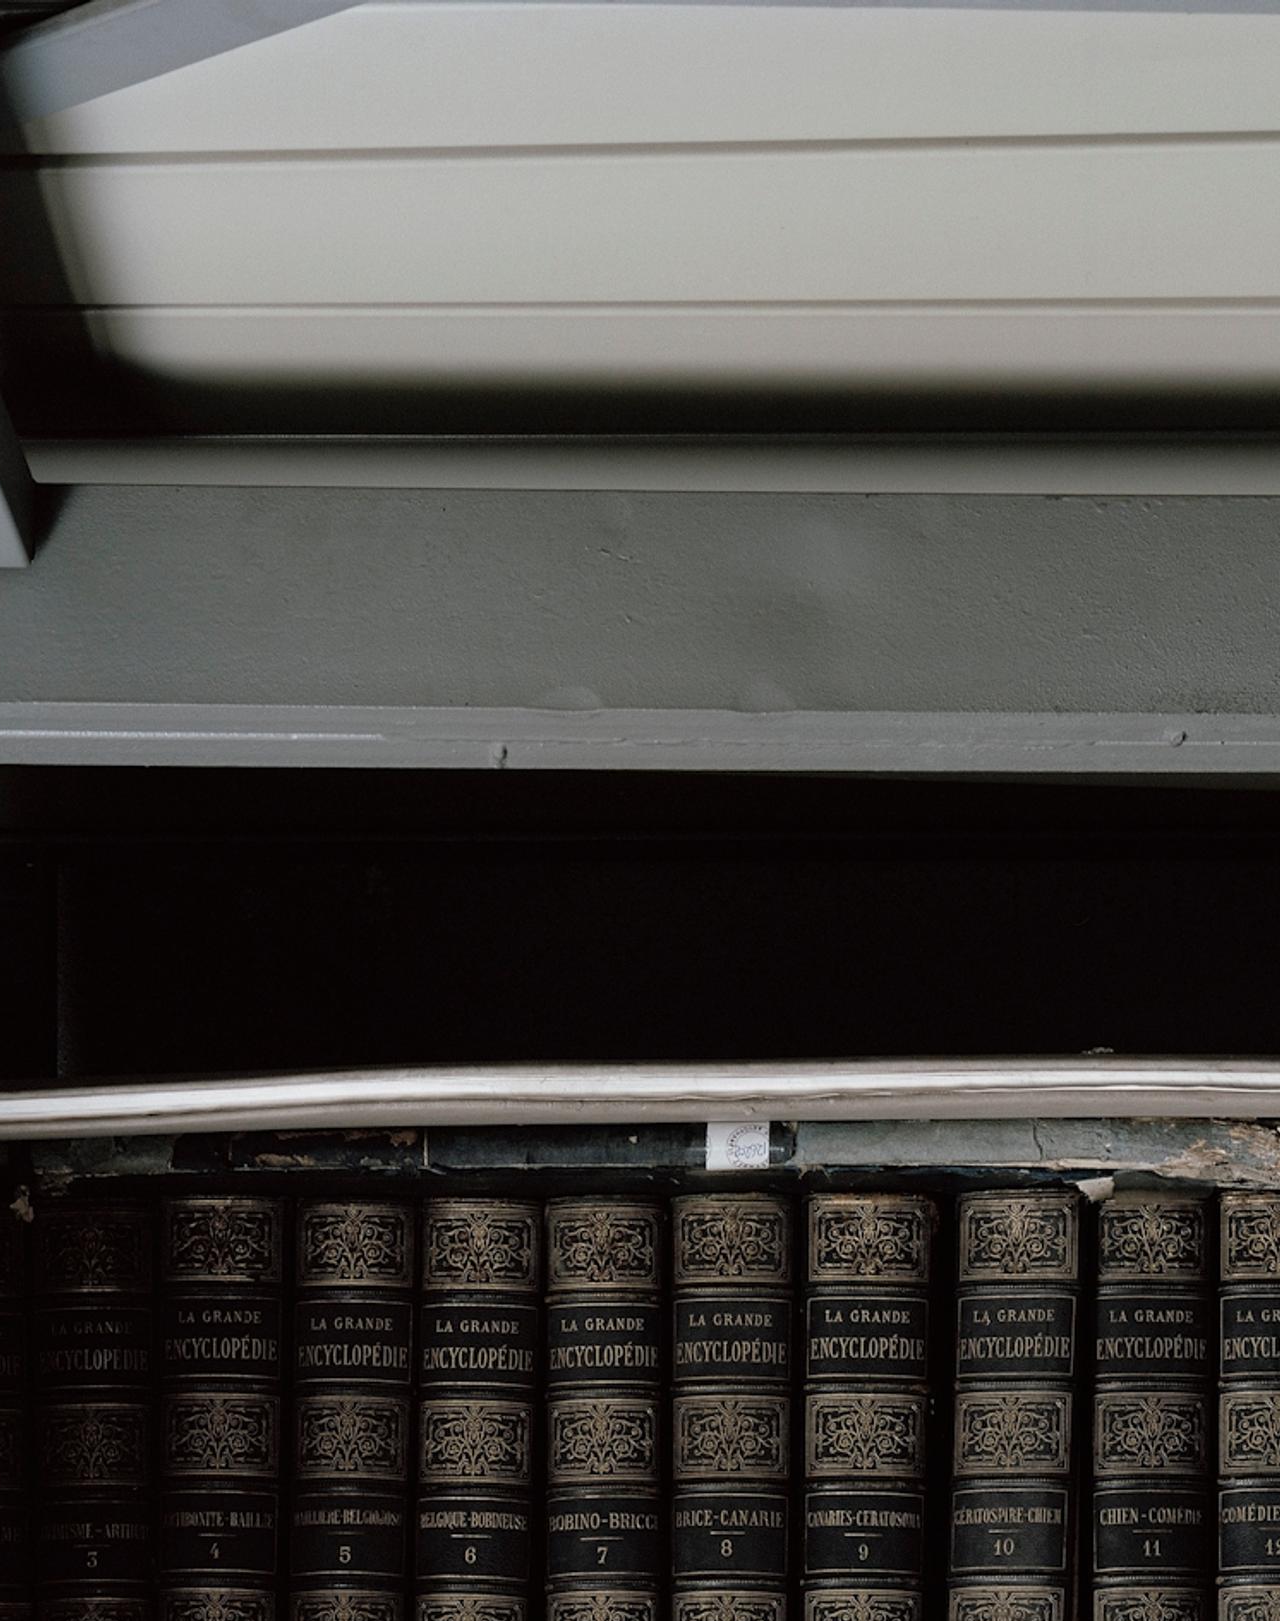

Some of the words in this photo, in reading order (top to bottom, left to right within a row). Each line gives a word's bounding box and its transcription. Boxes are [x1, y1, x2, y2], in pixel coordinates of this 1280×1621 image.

[178, 1311, 196, 1325] LA
[201, 1309, 263, 1325] GRANDE
[310, 1317, 327, 1331] LA
[334, 1316, 394, 1331] GRANDE
[560, 1318, 579, 1332] LA
[584, 1317, 645, 1331] GRANDE
[688, 1314, 707, 1328] LA
[713, 1312, 773, 1328] GRANDE
[824, 1308, 843, 1323] LA
[849, 1308, 911, 1325] GRANDE
[973, 1310, 990, 1325] LA
[997, 1308, 1056, 1324] GRANDE
[1109, 1310, 1128, 1324] LA
[1133, 1309, 1195, 1325] GRANDE
[1235, 1309, 1255, 1323] LA
[51, 1321, 67, 1336] LA
[73, 1320, 136, 1335] GRANDE
[435, 1319, 454, 1334] LA
[459, 1319, 521, 1335] GRANDE
[165, 1333, 278, 1361] ENCYCLOPÉDIE
[298, 1341, 408, 1368] ENCYCLOPÉDIE
[549, 1340, 659, 1369] ENCYCLOPÉDIE
[676, 1338, 788, 1365] ENCYCLOPÉDIE
[810, 1333, 925, 1361] ENCYCLOPÉDIE
[959, 1332, 1071, 1360] ENCYCLOPÉDIE
[1095, 1333, 1208, 1361] ENCYCLOPÉDIE
[423, 1344, 534, 1372] ENCYCLOPÉDIE
[675, 1509, 785, 1529] BRICE-CANARIE
[208, 1542, 221, 1560] 4
[338, 1545, 352, 1564] 5
[464, 1546, 477, 1564] 6
[596, 1546, 609, 1565] 7
[720, 1538, 733, 1558] 8
[857, 1543, 869, 1561] 9
[993, 1538, 1015, 1556] 10
[1141, 1538, 1162, 1558] 11
[86, 1551, 99, 1568] 3
